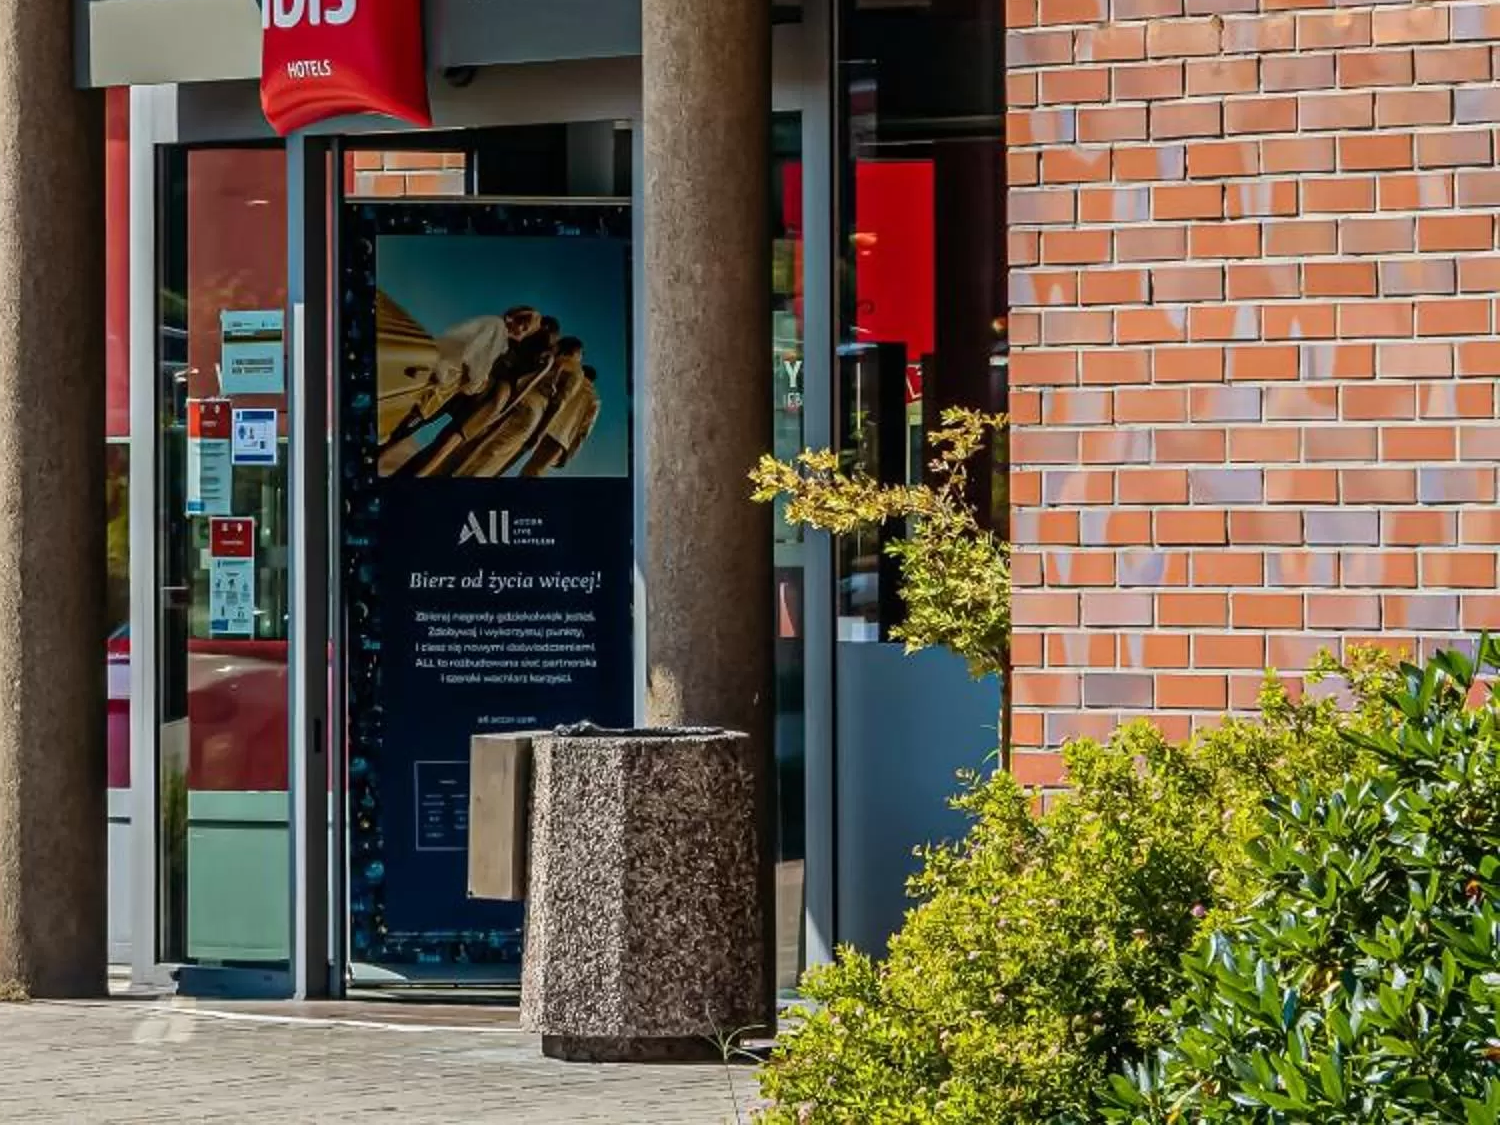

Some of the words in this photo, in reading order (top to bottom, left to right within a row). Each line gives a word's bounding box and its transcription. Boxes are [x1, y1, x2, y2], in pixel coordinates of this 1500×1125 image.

[287, 59, 332, 78] HOTELS
[409, 572, 456, 588] Bierz
[461, 569, 484, 588] od
[488, 572, 533, 594] życia
[539, 571, 602, 594] więcej!
